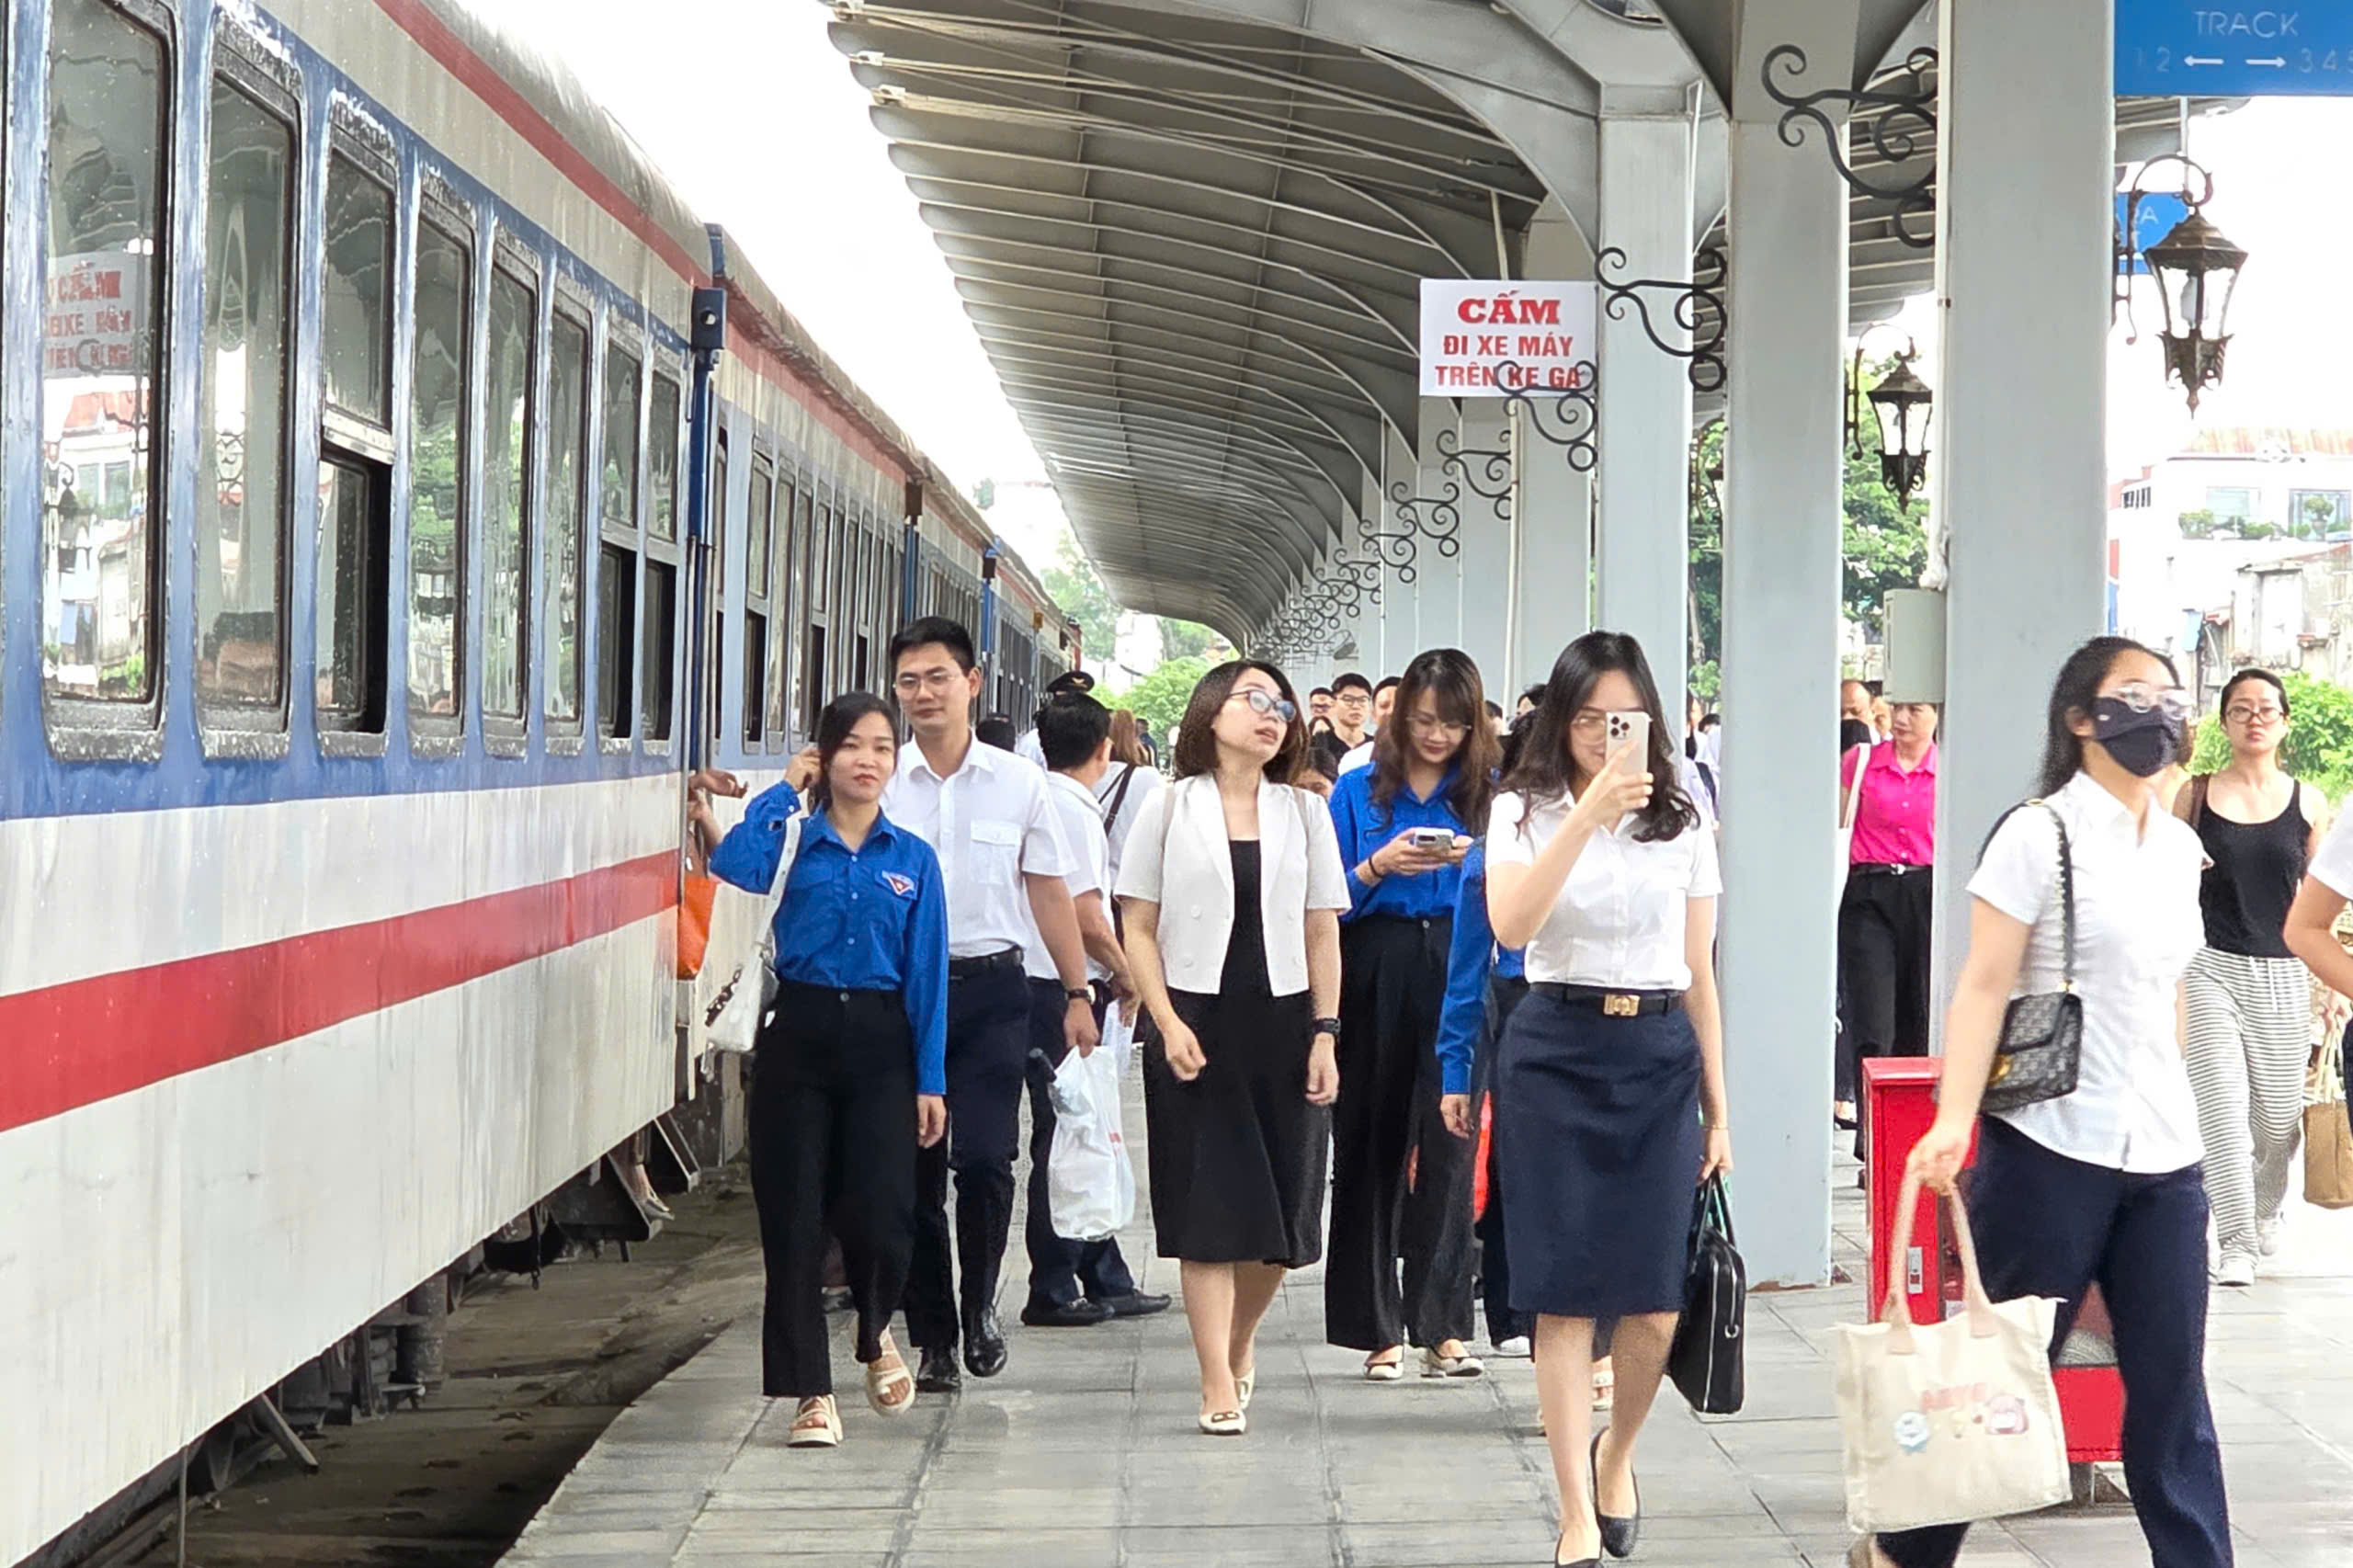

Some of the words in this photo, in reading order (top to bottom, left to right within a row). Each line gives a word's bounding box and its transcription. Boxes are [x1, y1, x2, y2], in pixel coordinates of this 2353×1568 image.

[2194, 11, 2299, 38] TRACK
[1458, 290, 1561, 324] CẤM
[1443, 335, 1468, 356] ĐI
[1477, 335, 1507, 356] XE
[1518, 332, 1573, 357] MÁY
[1435, 362, 1497, 386] TRÊN
[1508, 367, 1538, 387] KE
[1549, 368, 1581, 388] GA
